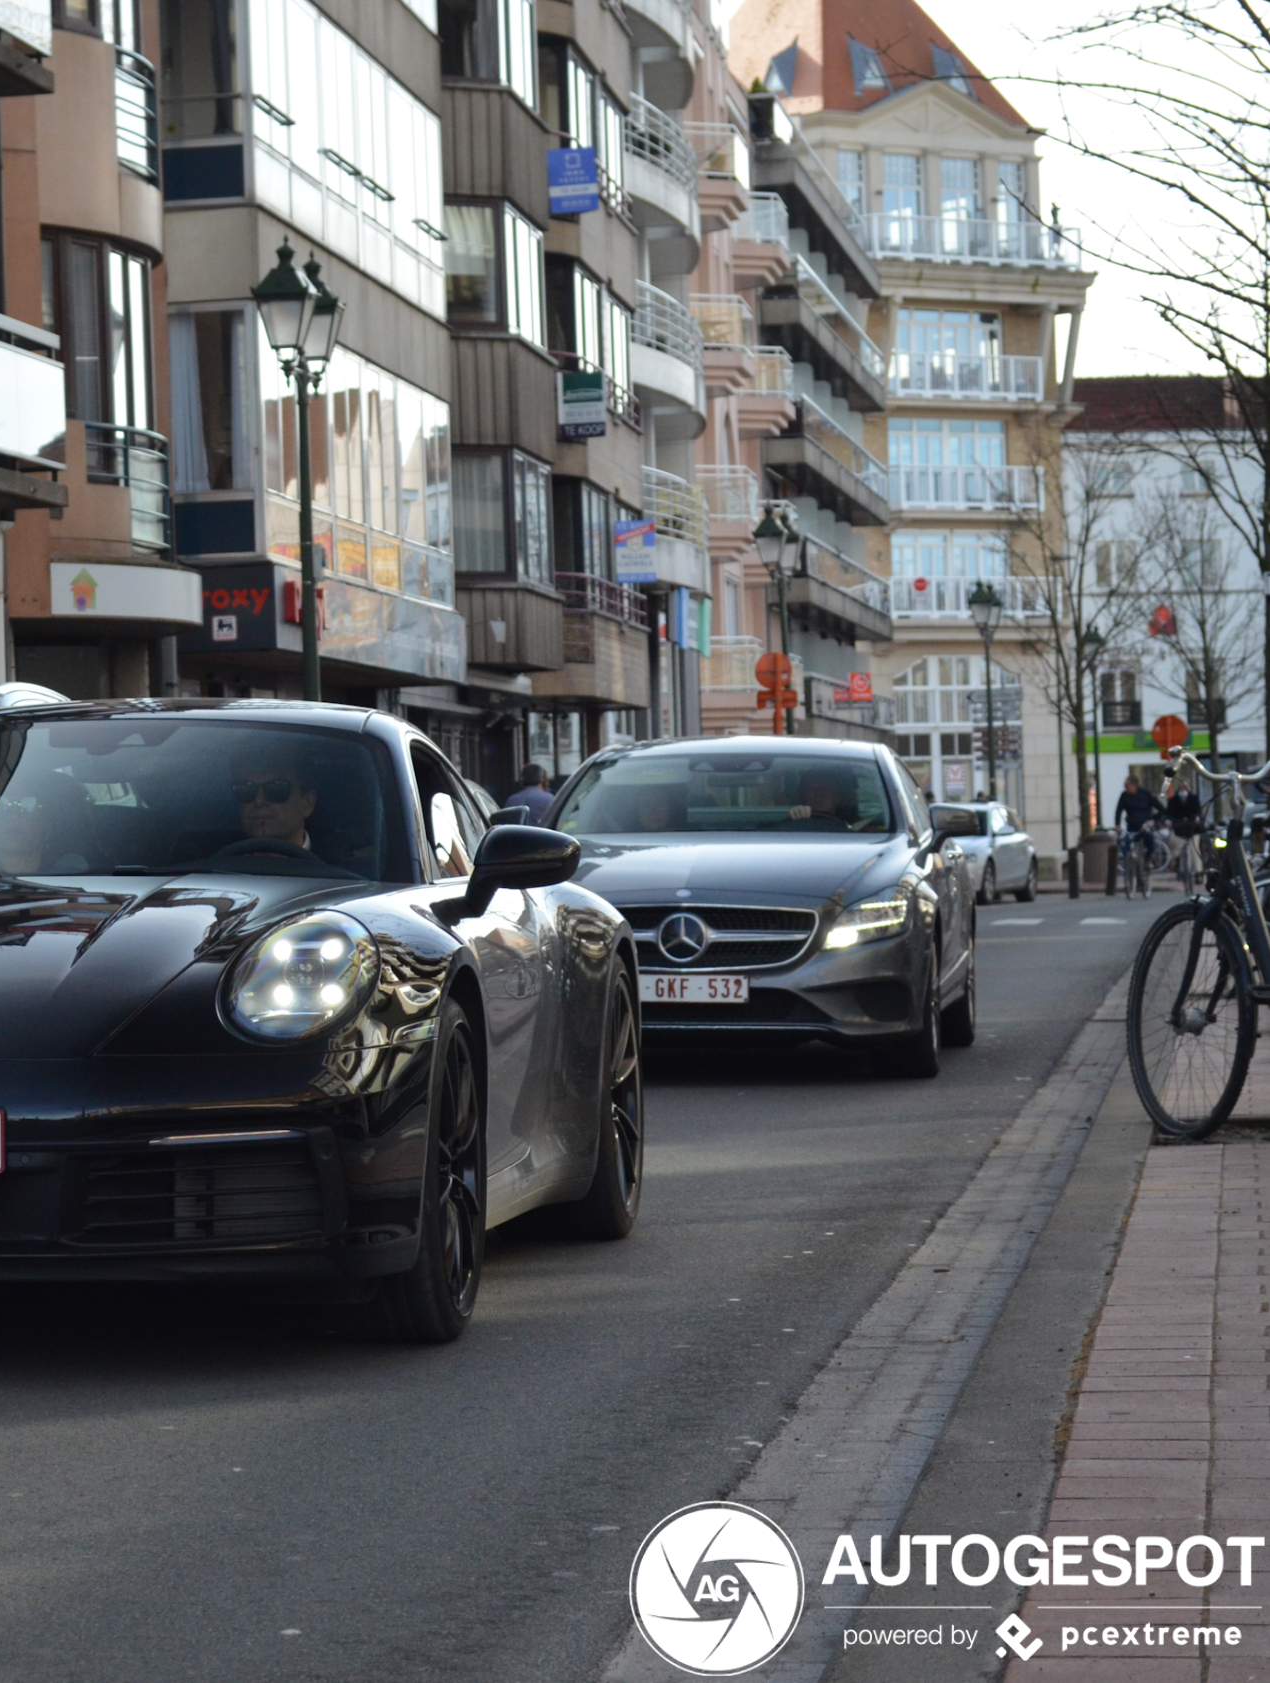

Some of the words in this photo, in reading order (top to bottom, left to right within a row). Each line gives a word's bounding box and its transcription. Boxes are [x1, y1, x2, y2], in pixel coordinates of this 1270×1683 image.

[564, 426, 576, 436] TE
[577, 424, 605, 436] KOOP
[201, 587, 270, 615] roxy
